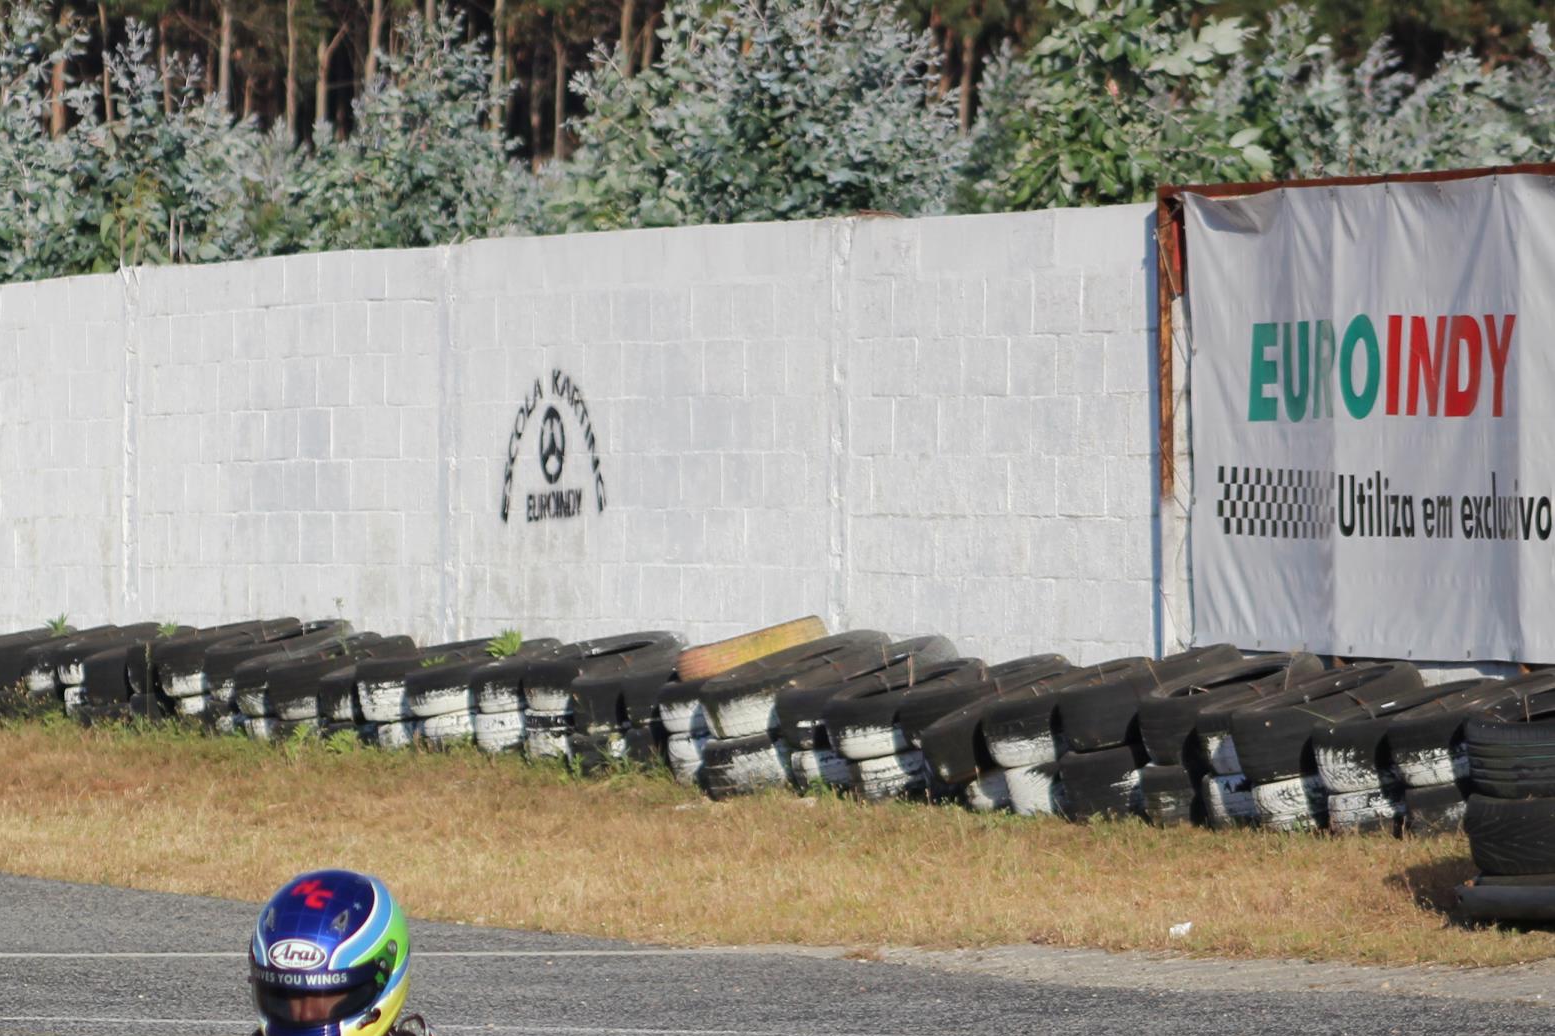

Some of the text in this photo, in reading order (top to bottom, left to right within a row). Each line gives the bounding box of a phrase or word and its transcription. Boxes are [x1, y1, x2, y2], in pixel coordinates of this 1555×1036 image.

[1247, 312, 1517, 422] EUROINDY
[500, 368, 607, 524] ESCOLA KARTING
[526, 487, 582, 523] EUROINDY
[1337, 470, 1552, 541] Utiliza em exclusivo
[272, 943, 318, 961] Arai
[277, 973, 302, 985] YOU
[305, 973, 348, 986] WINGS
